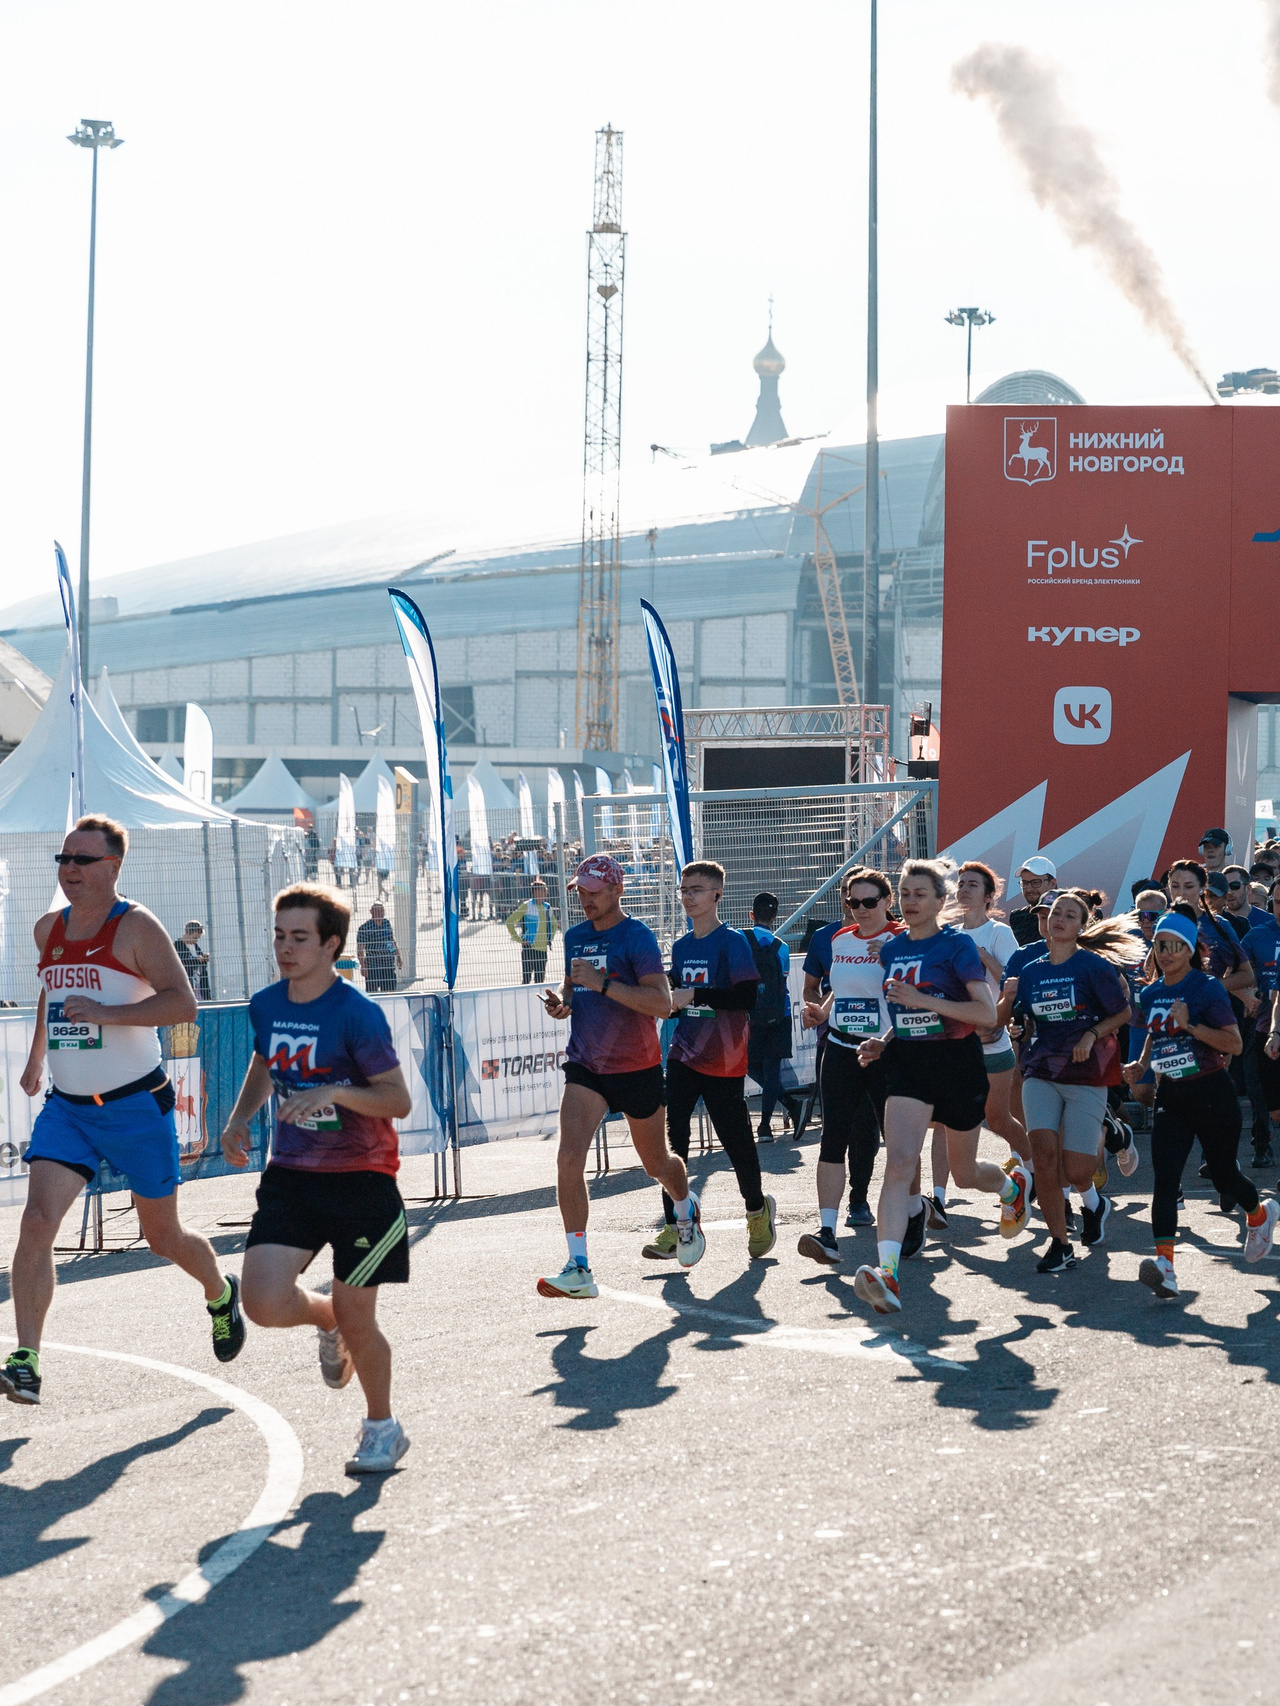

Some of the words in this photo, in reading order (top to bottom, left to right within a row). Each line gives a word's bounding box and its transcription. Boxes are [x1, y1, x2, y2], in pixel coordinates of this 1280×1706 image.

[1069, 428, 1165, 449] НИЖНИЙ
[1069, 456, 1185, 475] НОВГОРОД
[1027, 539, 1120, 575] Fplus
[1027, 626, 1141, 646] купер
[45, 967, 102, 992] RUSSIA
[1039, 1002, 1064, 1012] 7676
[843, 1015, 870, 1023] 6921
[902, 1017, 931, 1025] 6780
[53, 1026, 90, 1036] 8628
[273, 1021, 319, 1031] МАРАФОН
[1157, 1057, 1187, 1070] 7680
